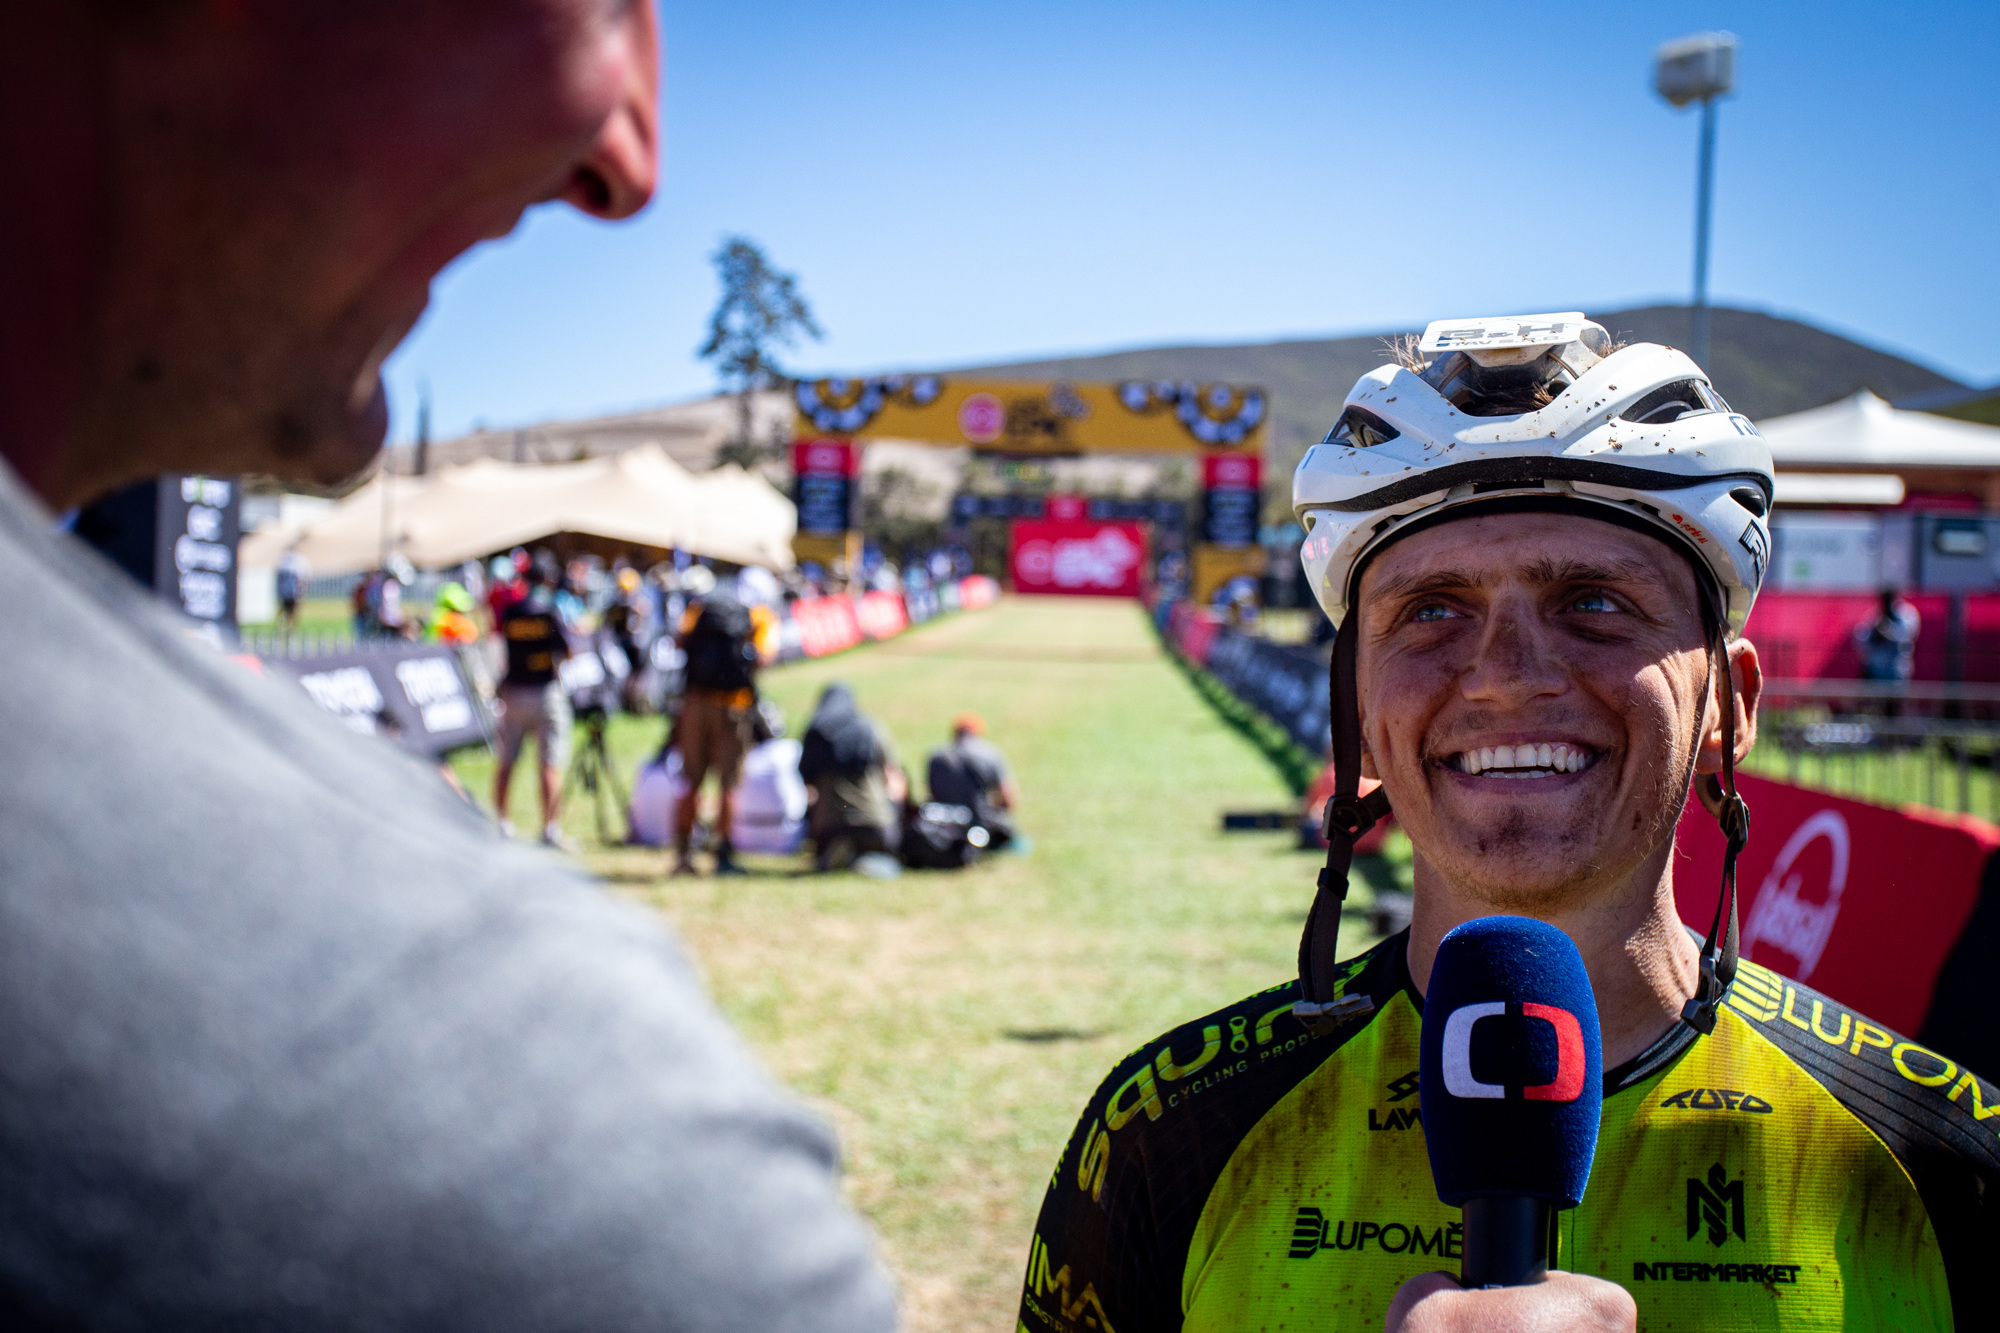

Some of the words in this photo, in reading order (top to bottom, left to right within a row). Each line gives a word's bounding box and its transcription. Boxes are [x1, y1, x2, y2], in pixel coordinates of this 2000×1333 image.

[1168, 1060, 1248, 1107] CYCLING
[1660, 1088, 1773, 1113] TUFO
[1633, 1262, 1801, 1283] INTERMARKET
